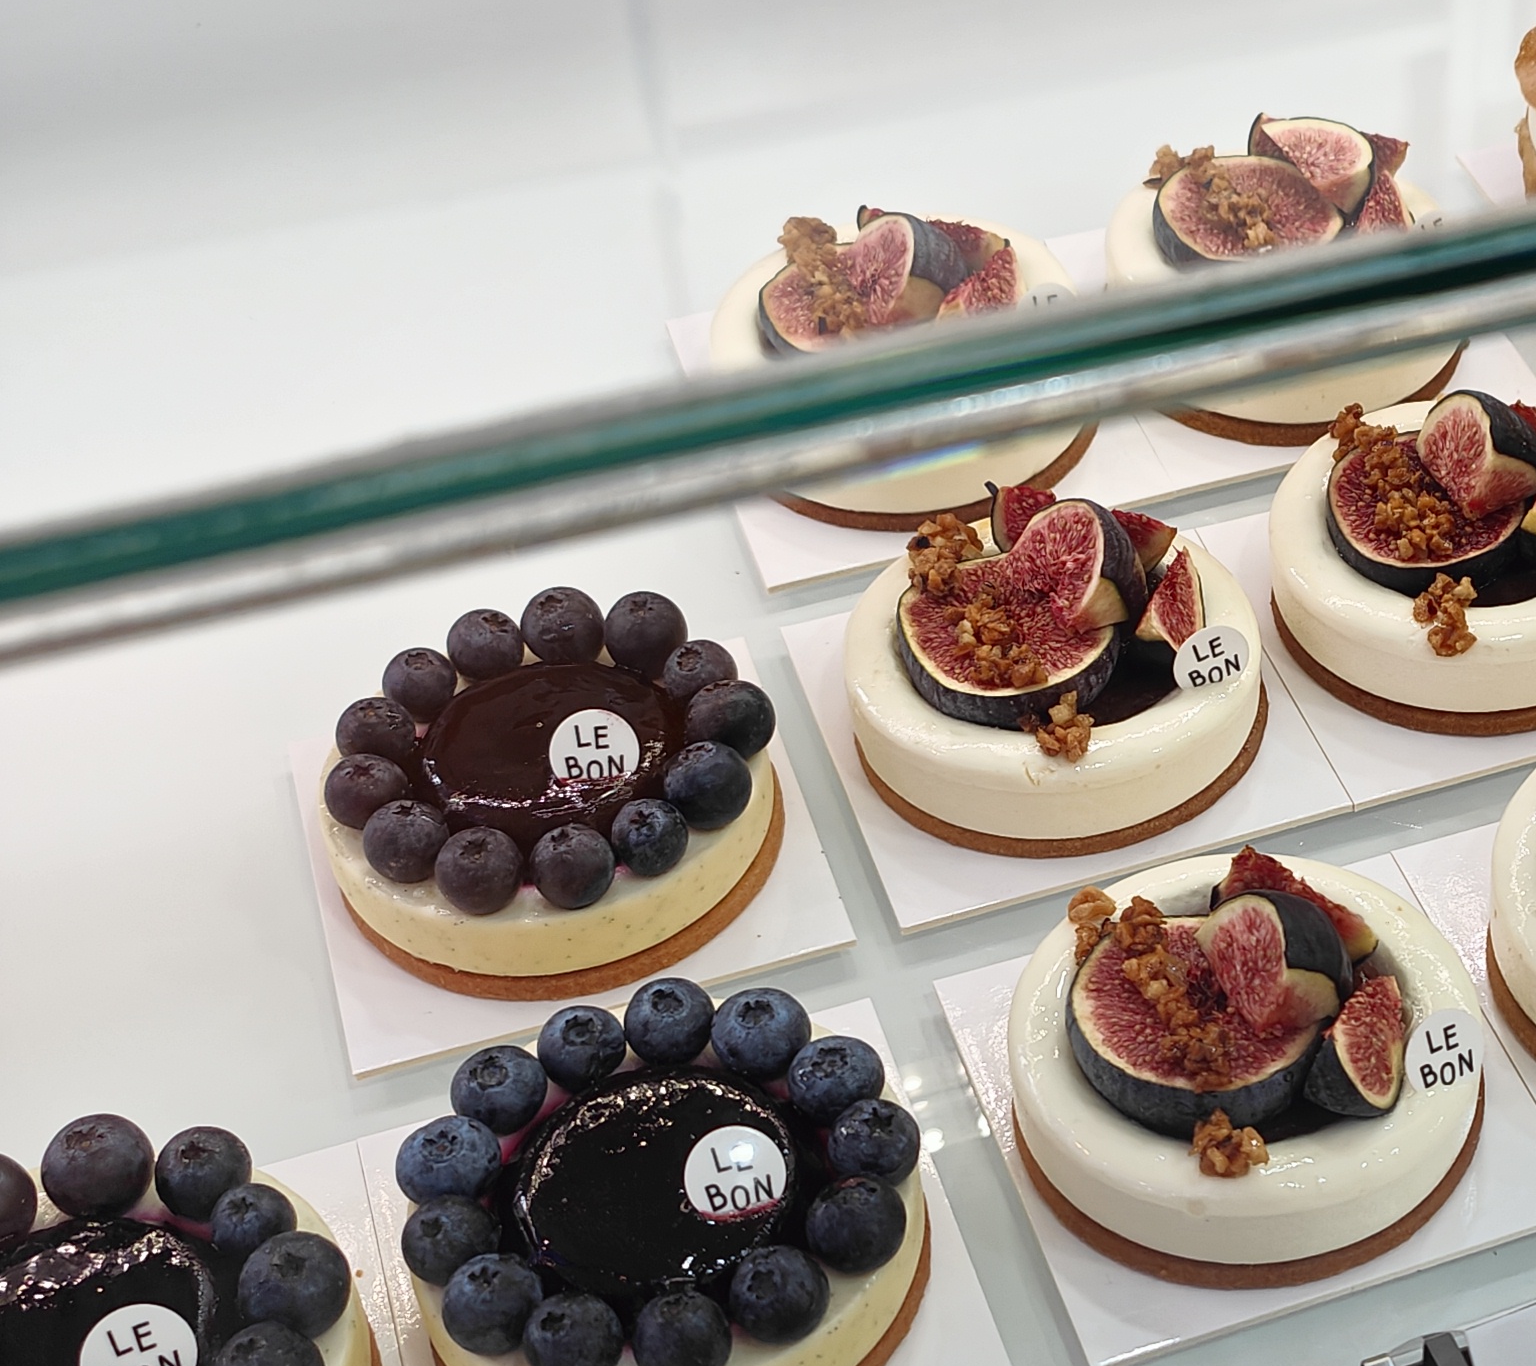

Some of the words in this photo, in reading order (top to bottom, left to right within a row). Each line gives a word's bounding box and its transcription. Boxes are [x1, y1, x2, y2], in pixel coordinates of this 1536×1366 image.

[1192, 636, 1224, 662] LE
[1188, 654, 1240, 687] BON
[575, 725, 608, 748] LE
[566, 755, 624, 779] BON
[1426, 1024, 1459, 1053] LE
[1420, 1053, 1473, 1088] BON
[711, 1146, 753, 1173] L
[705, 1174, 774, 1212] BON
[107, 1321, 157, 1357] LE
